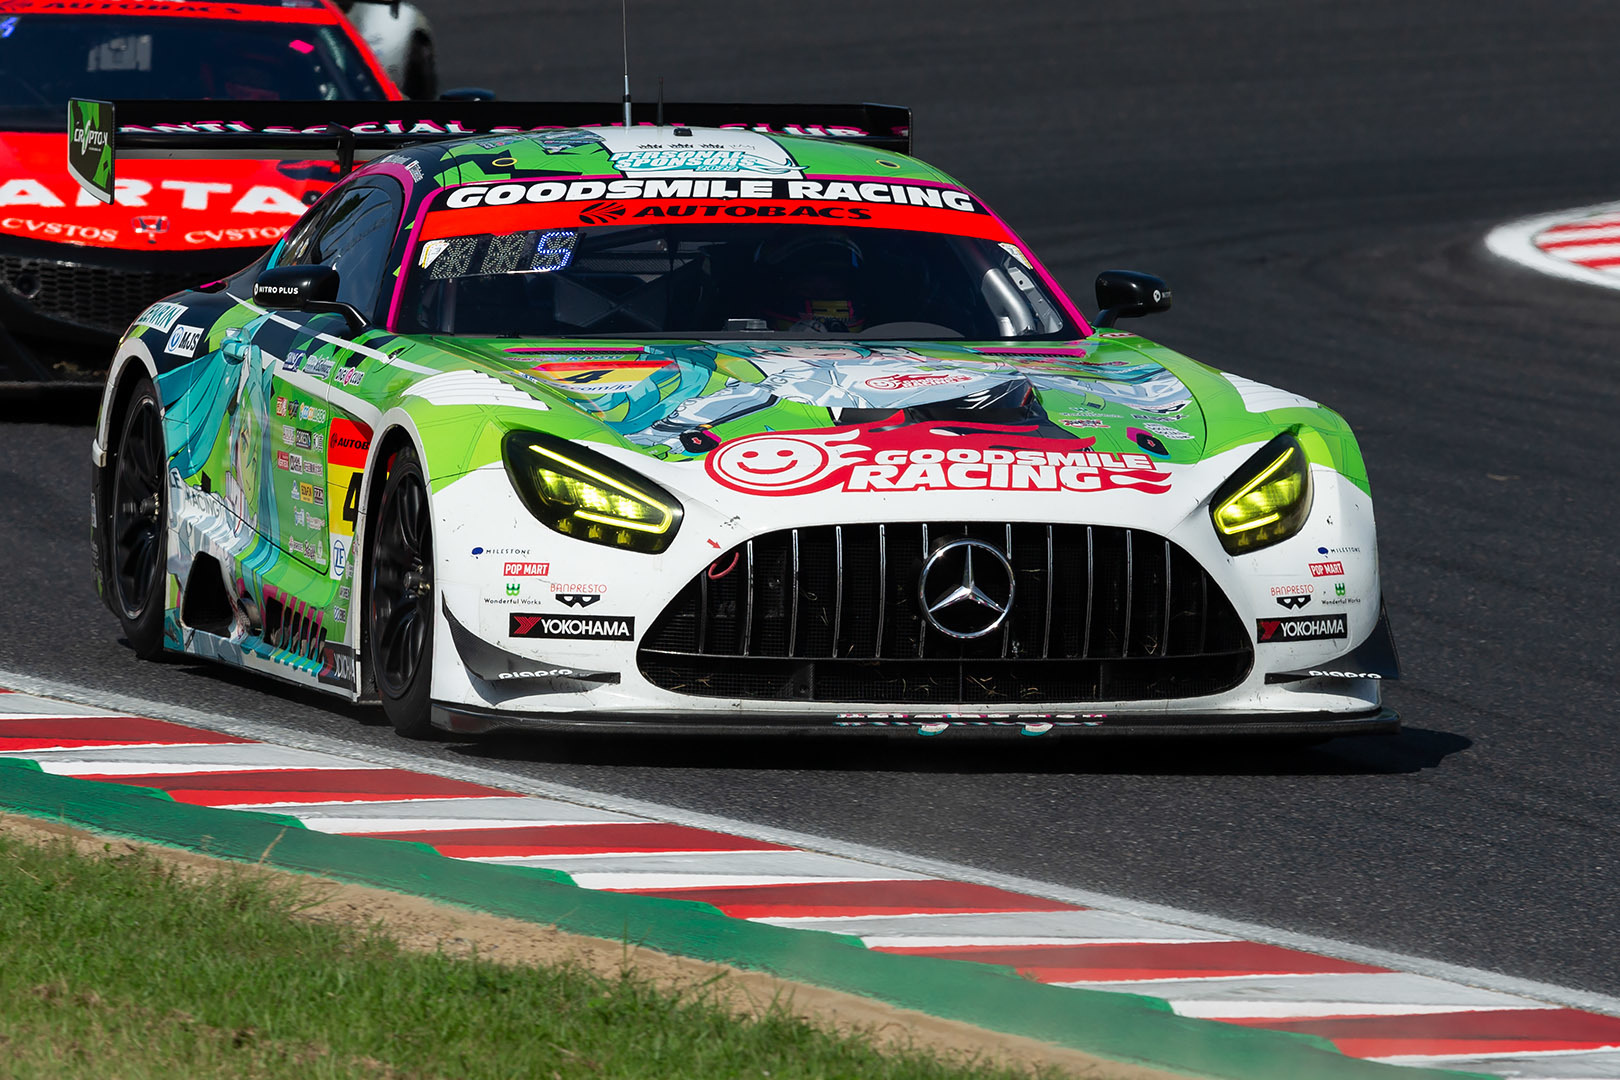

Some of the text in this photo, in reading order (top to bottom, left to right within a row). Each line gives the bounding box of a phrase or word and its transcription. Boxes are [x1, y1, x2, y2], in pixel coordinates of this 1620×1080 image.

[42, 2, 243, 14] AUTOBACS
[611, 151, 746, 161] PERSONAL
[616, 157, 759, 168] SPONSORS
[0, 178, 310, 216] ARTA
[446, 179, 975, 212] GOODSMILE RACING
[632, 204, 872, 220] AUTOBACS
[2, 217, 119, 243] CVSTOS
[258, 285, 299, 295] NITRO PLUS
[556, 369, 615, 384] 4
[337, 437, 370, 450] AUTOB
[874, 449, 1154, 470] GOODSMILE
[847, 464, 1102, 490] RACING
[342, 472, 364, 532] 4
[505, 564, 549, 575] POP MART
[1310, 563, 1344, 576] POP MART
[550, 583, 607, 593] BANPRESTO
[1270, 584, 1315, 597] BANPRESTO
[540, 618, 630, 636] YOKOHAMA
[1280, 619, 1345, 637] YOKOHAMA
